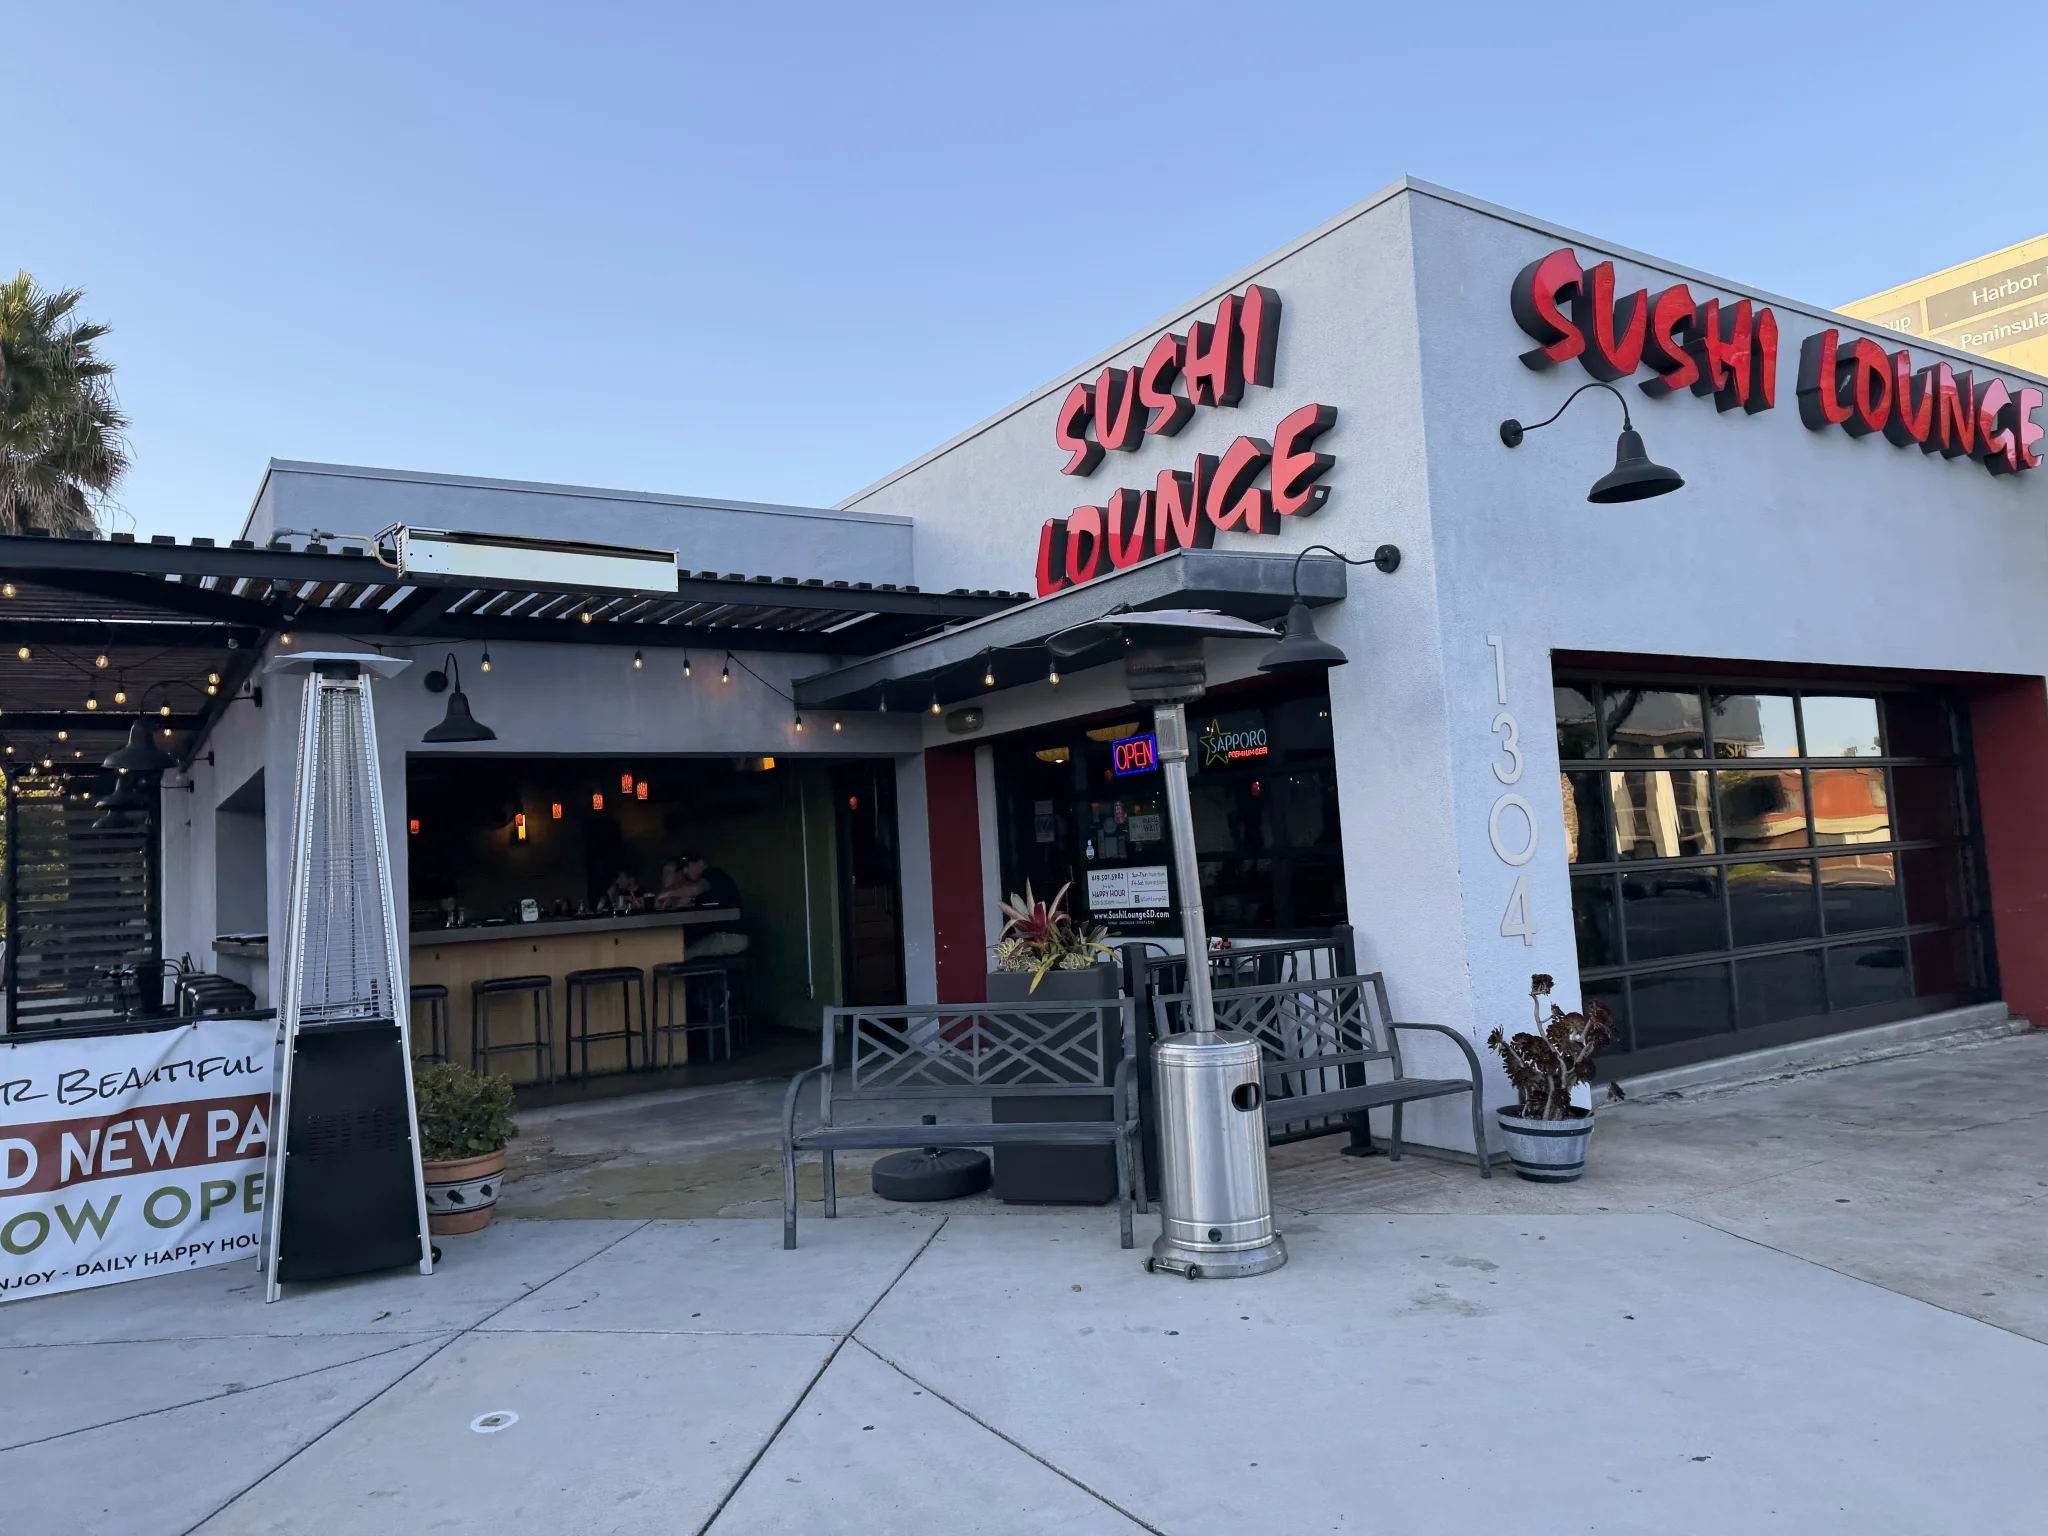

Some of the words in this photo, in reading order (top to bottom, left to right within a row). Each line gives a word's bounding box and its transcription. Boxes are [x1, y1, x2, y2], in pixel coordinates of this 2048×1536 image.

[1972, 273, 2041, 306] Harbor
[1961, 311, 2048, 350] Peninsula
[1056, 284, 1282, 476] SUSHI
[1511, 247, 1779, 415] SUSHI
[1796, 328, 2045, 476] LOUNGE
[1035, 403, 1338, 598] LOUNGE
[1115, 739, 1154, 770] OPEN
[1209, 728, 1267, 754] SAPPORO
[1486, 635, 1539, 947] 1304
[1110, 889, 1126, 898] HOUR
[1094, 909, 1170, 920] www.SushiLoungeSD.com
[60, 1113, 190, 1183] NEW
[207, 1104, 268, 1158] PA
[0, 1194, 123, 1256] OW
[143, 1172, 264, 1230] OPE
[76, 1254, 138, 1278] DAILY
[144, 1241, 215, 1266] HAPPY
